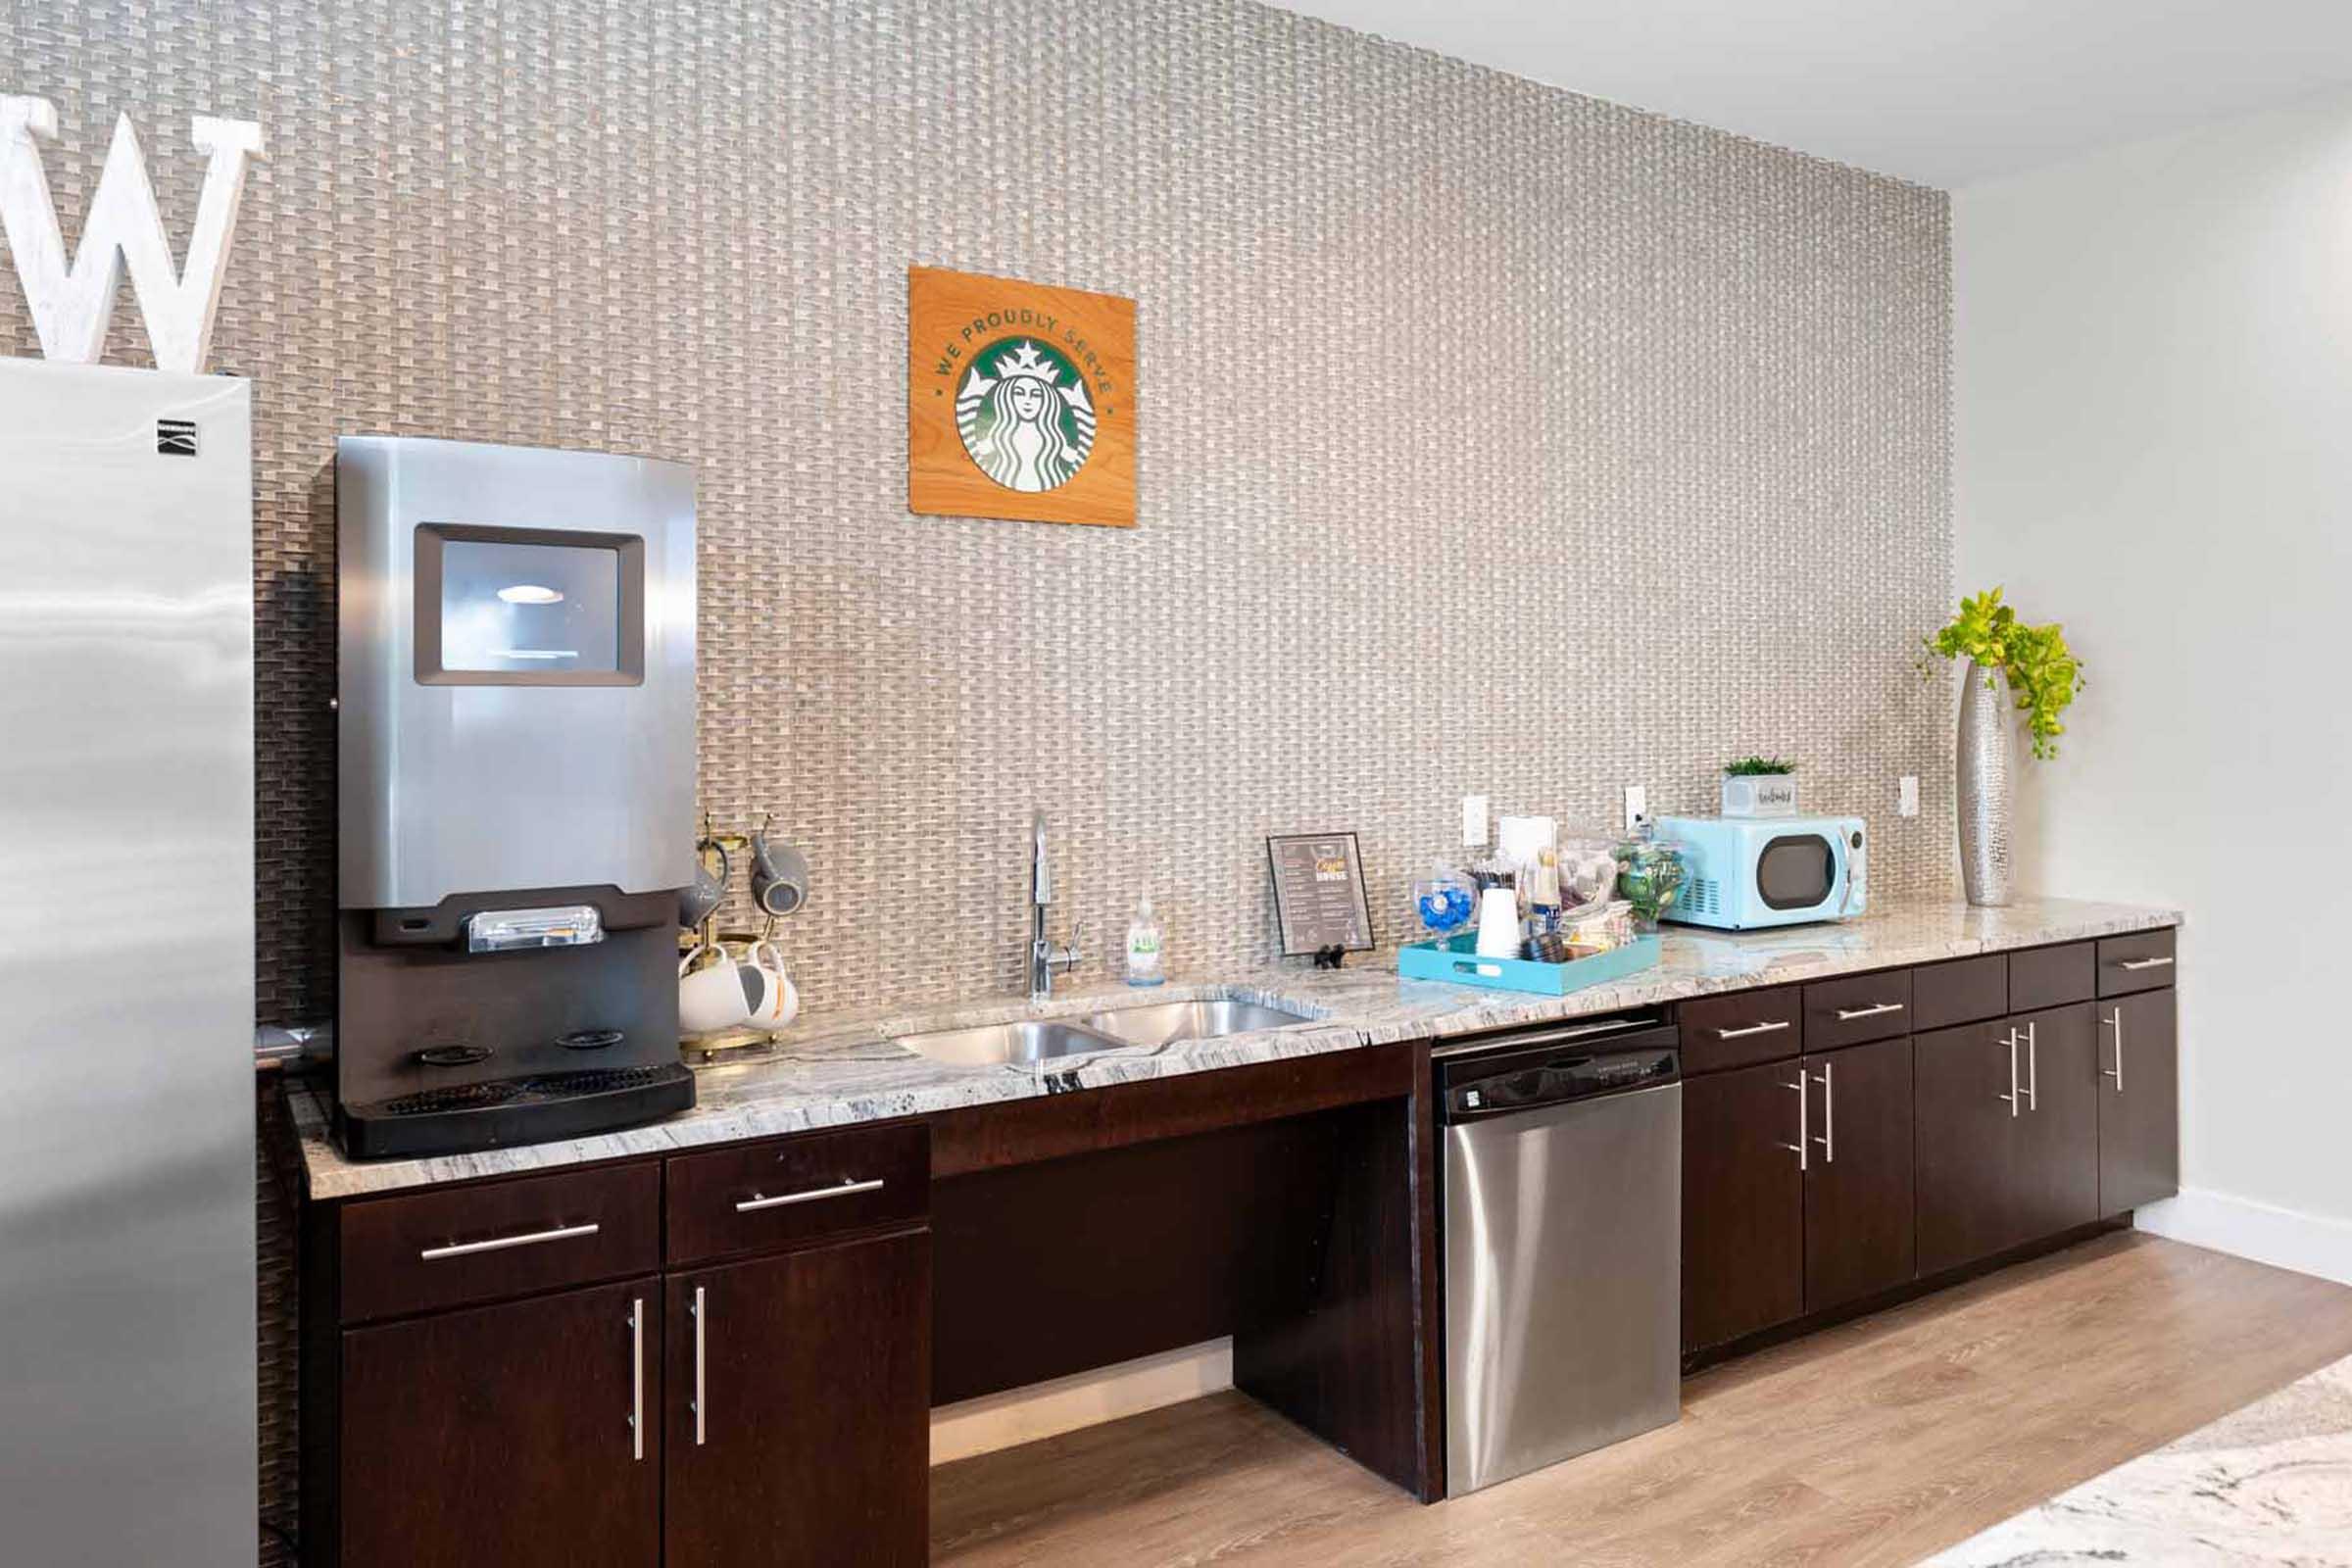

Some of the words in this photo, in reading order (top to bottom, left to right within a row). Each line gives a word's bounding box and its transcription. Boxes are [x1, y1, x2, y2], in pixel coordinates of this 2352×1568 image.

[0, 95, 265, 373] W
[936, 344, 960, 376] WE
[962, 309, 1058, 342] PROUDLY
[1064, 329, 1112, 393] SERVE
